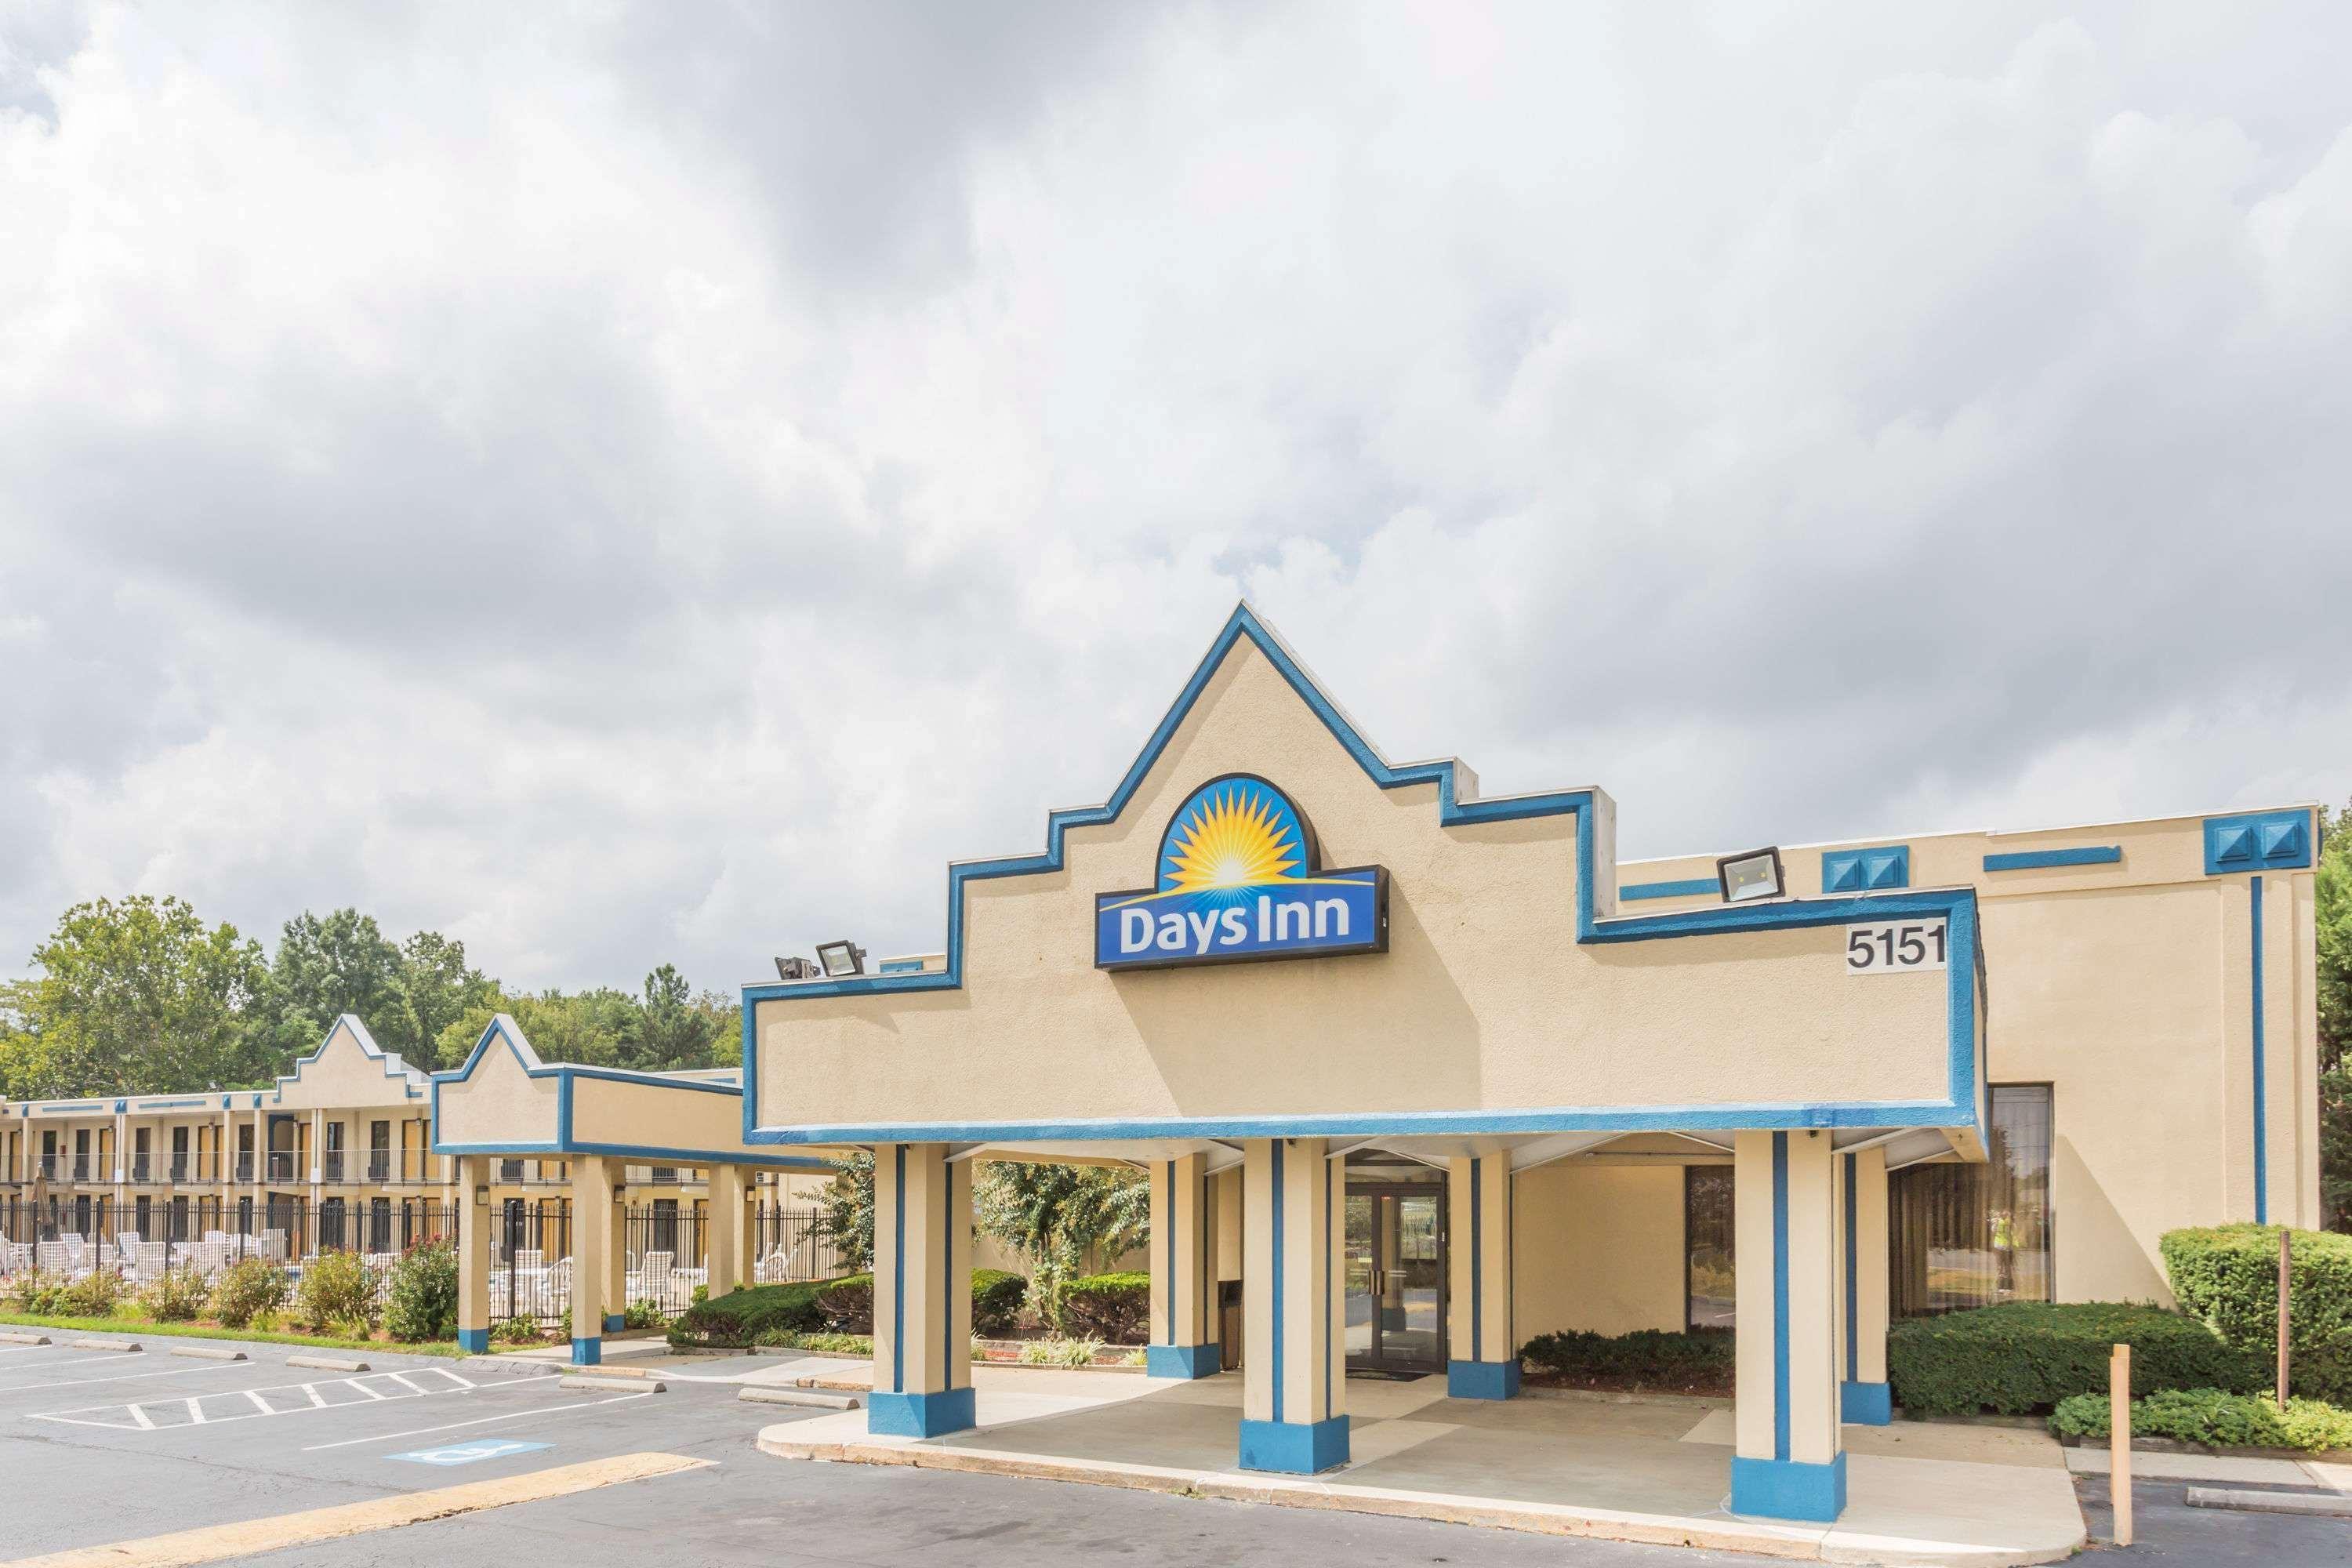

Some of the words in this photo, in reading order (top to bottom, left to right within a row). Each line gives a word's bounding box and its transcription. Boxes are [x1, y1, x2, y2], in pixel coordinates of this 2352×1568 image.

[1121, 907, 1247, 955] Days
[1258, 895, 1349, 942] Inn
[1847, 924, 1945, 968] 5151
